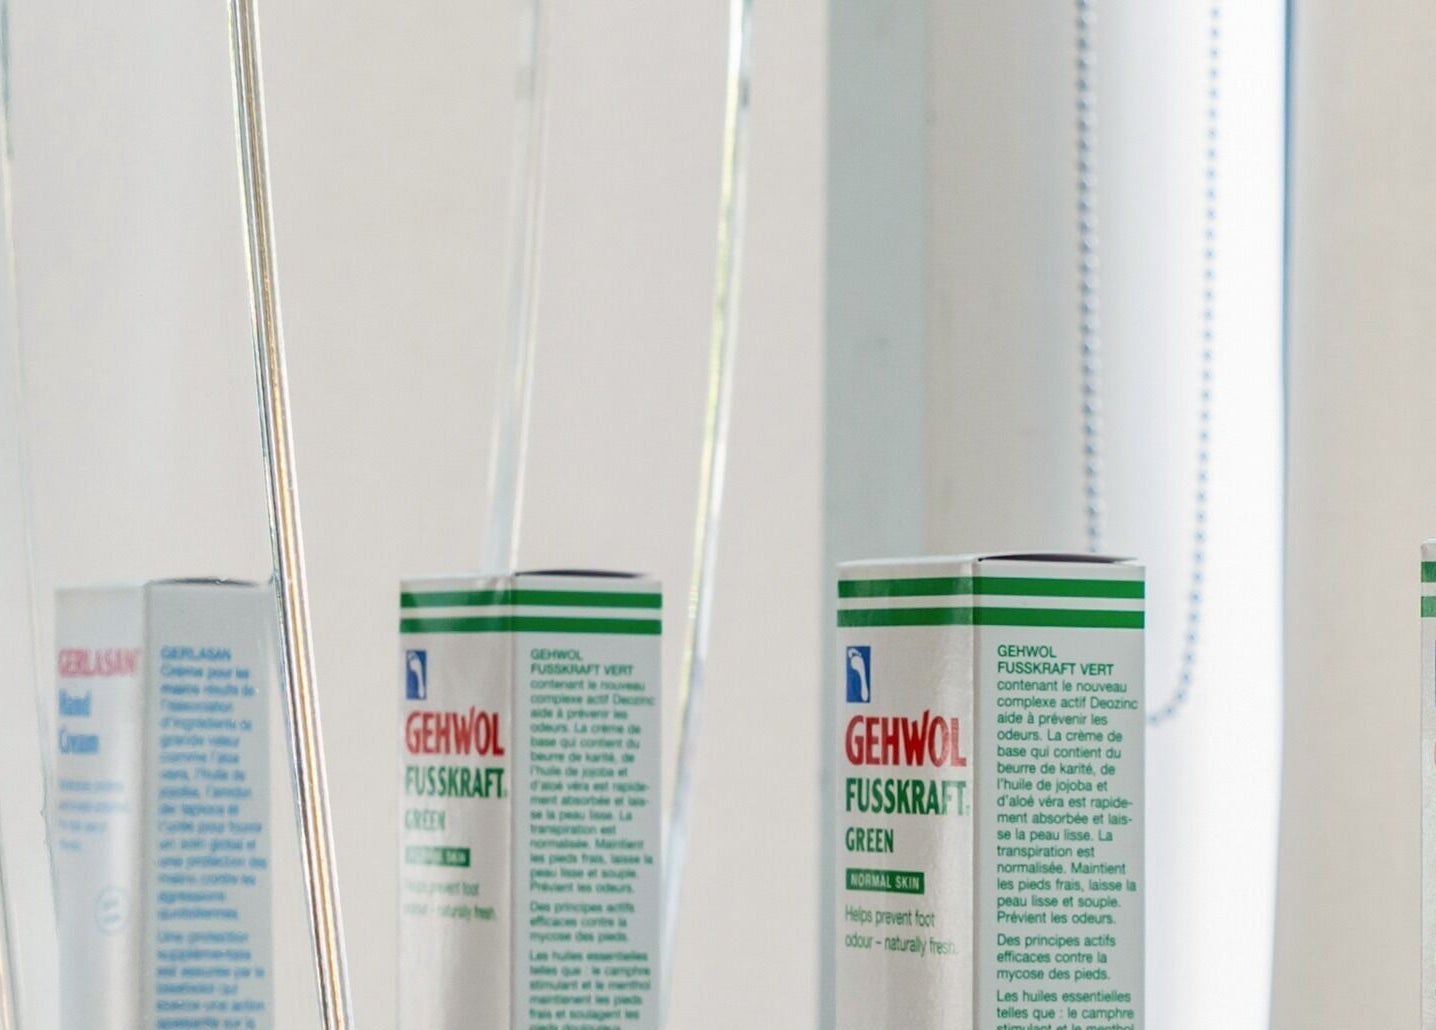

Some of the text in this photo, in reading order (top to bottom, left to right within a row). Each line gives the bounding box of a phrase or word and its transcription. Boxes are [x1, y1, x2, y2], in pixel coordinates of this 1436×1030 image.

[997, 644, 1056, 658] GEHWOL
[997, 661, 1114, 677] FUSSKRAFT VERT
[997, 679, 1127, 694] contenant le nouveau
[996, 695, 1139, 710] complexe actif Deozinc
[997, 711, 1023, 725] aide
[1090, 714, 1108, 726] les
[405, 706, 505, 756] GEHWOL
[845, 709, 967, 767] GEHWOL
[405, 809, 446, 831] GREEN
[845, 827, 894, 853] GREEN
[850, 873, 919, 890] NORMAL SKIN
[845, 905, 935, 927] Helps prevent foot
[845, 932, 873, 948] odour
[884, 935, 926, 957] naturally
[996, 933, 1117, 949] Des principes actifs
[996, 950, 1107, 964] efficaces contre la
[996, 967, 1112, 983] mycose des pieds.
